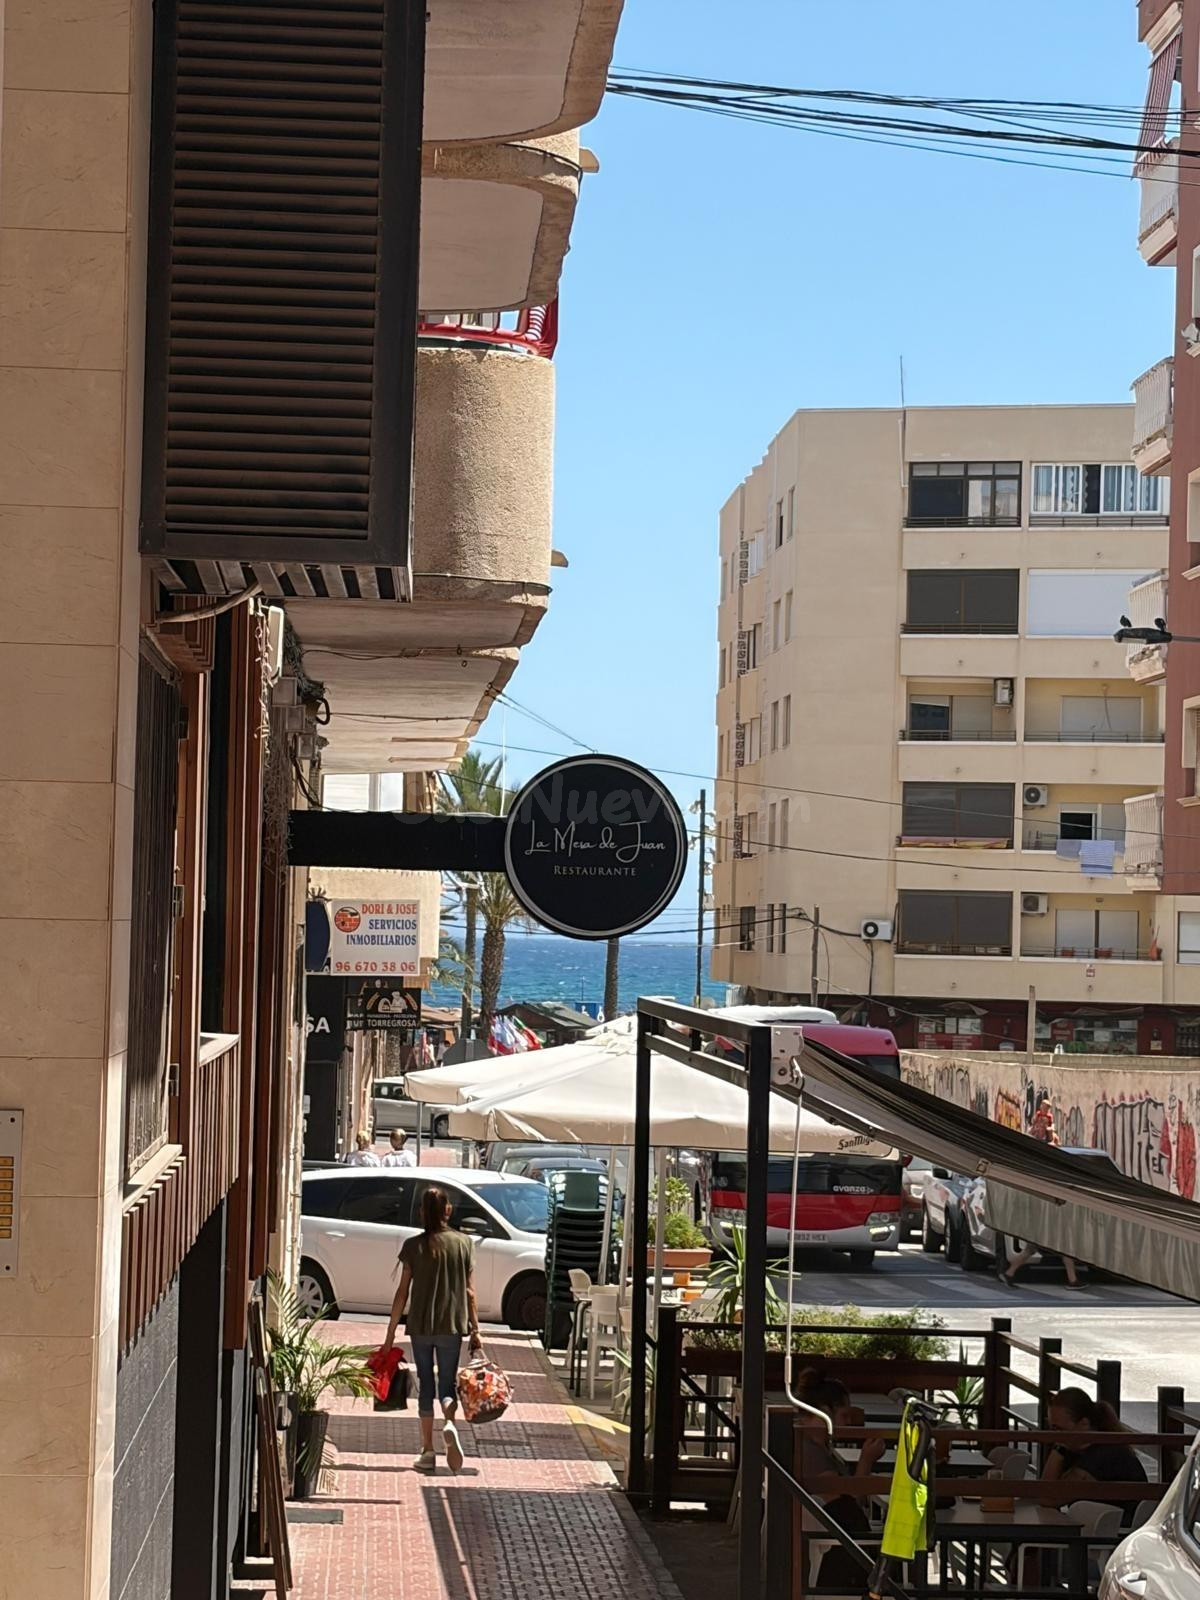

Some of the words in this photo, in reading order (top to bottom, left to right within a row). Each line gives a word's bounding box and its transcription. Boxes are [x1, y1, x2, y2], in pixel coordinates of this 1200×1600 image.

[525, 820, 551, 855] La
[554, 821, 598, 857] Mesa
[598, 826, 618, 849] de
[615, 820, 666, 863] Juan
[362, 903, 385, 914] DORI
[386, 904, 394, 914] &
[368, 919, 417, 930] SERVICIOS
[346, 934, 417, 945] INMOBILIARIOS
[335, 961, 351, 972] 96
[355, 961, 378, 972] 670
[381, 961, 397, 972] 38
[400, 961, 416, 972] 06
[367, 1019, 417, 1028] TORREGROSA
[832, 1185, 866, 1193] avanza
